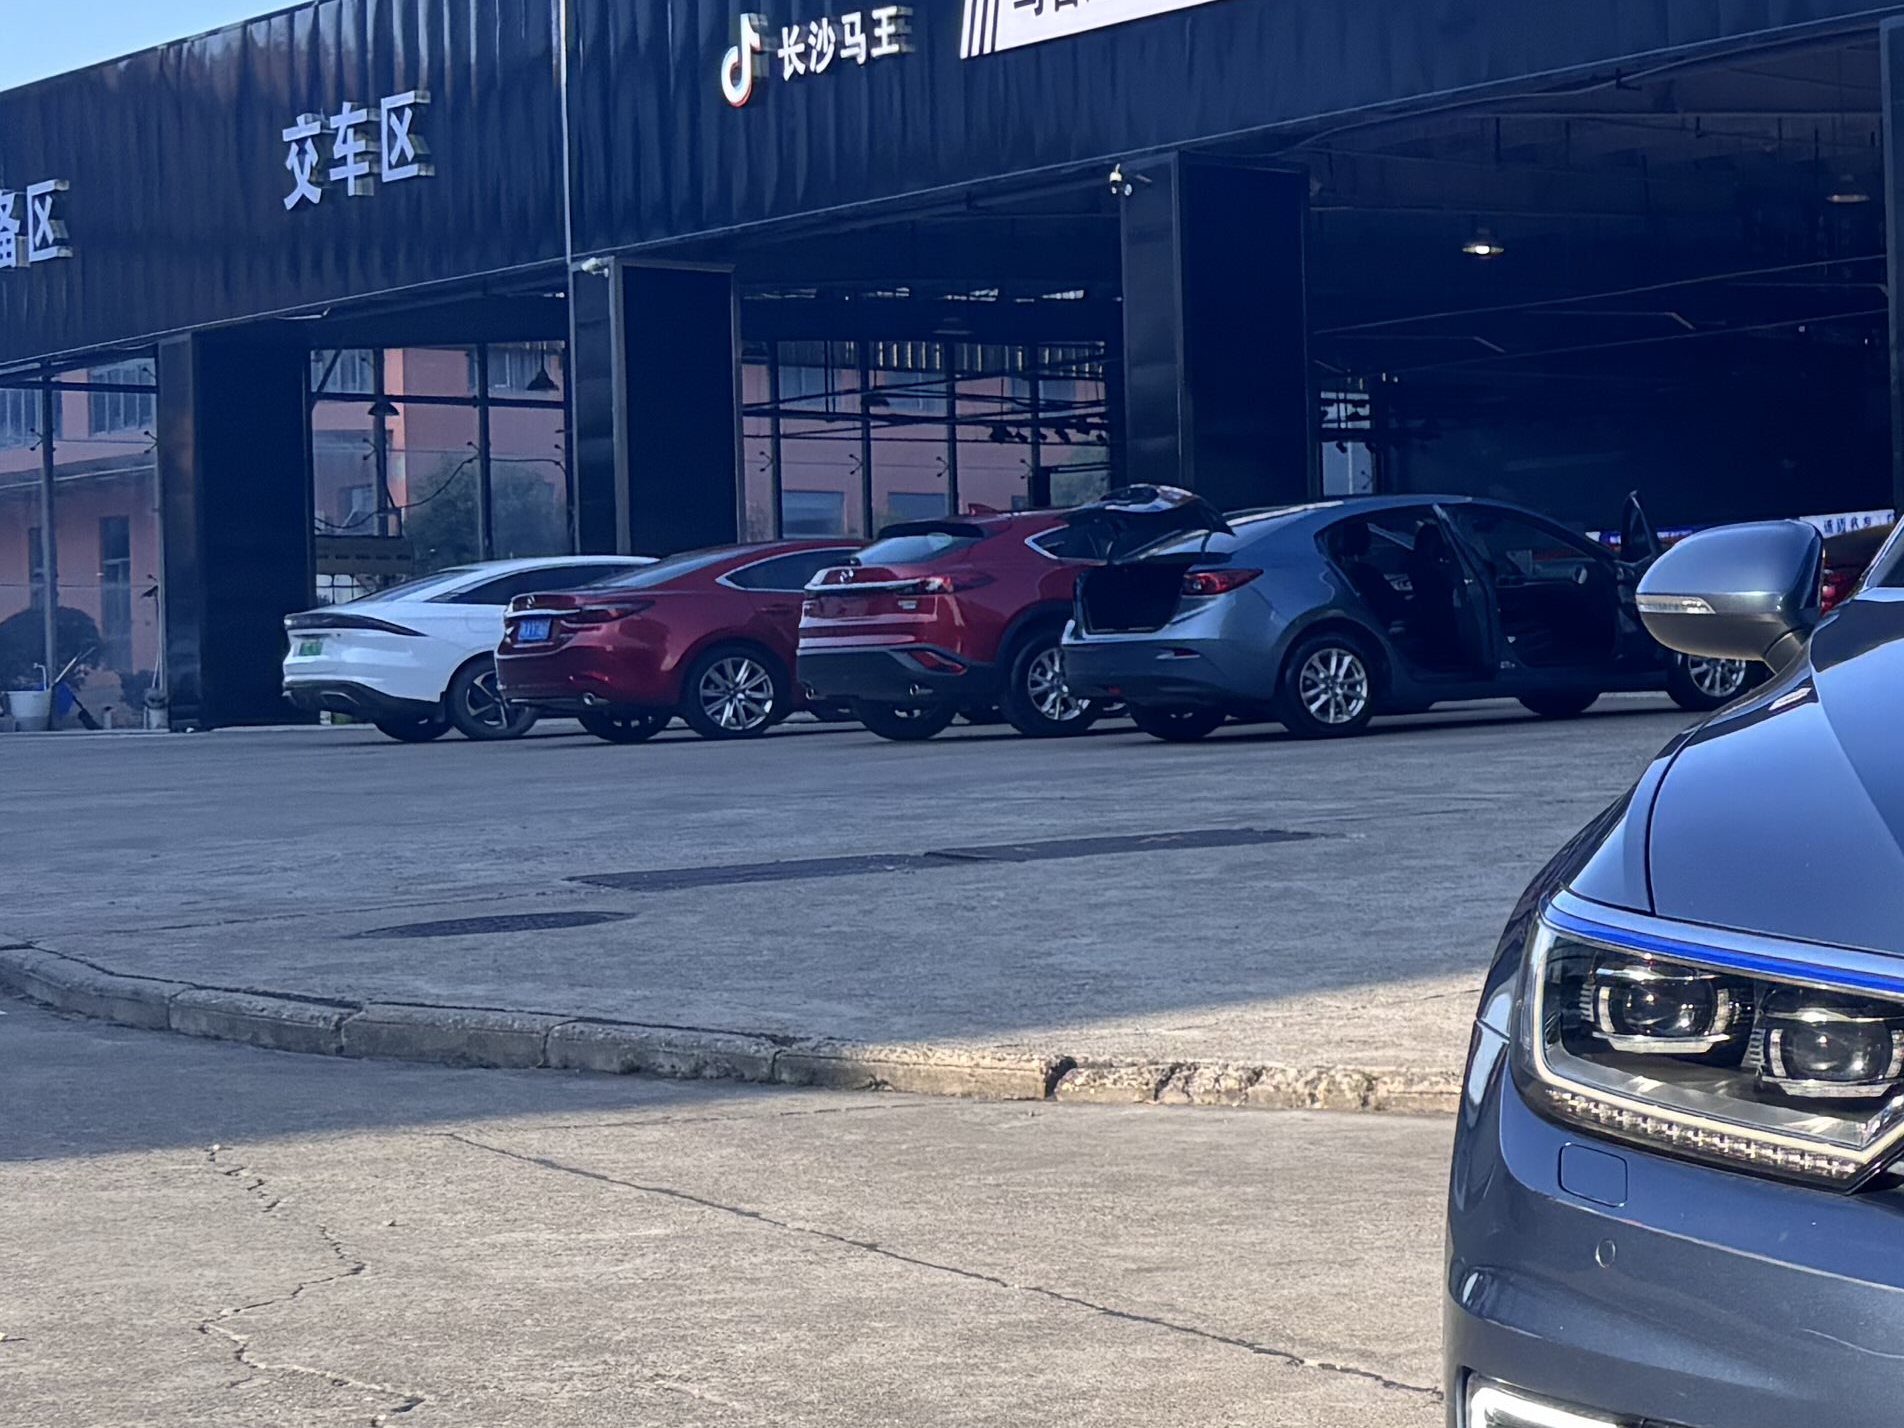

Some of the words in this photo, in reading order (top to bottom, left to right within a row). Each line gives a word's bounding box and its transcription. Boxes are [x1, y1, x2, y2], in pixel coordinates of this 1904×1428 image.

[777, 8, 903, 83] 长沙马王
[283, 90, 424, 210] 交车区
